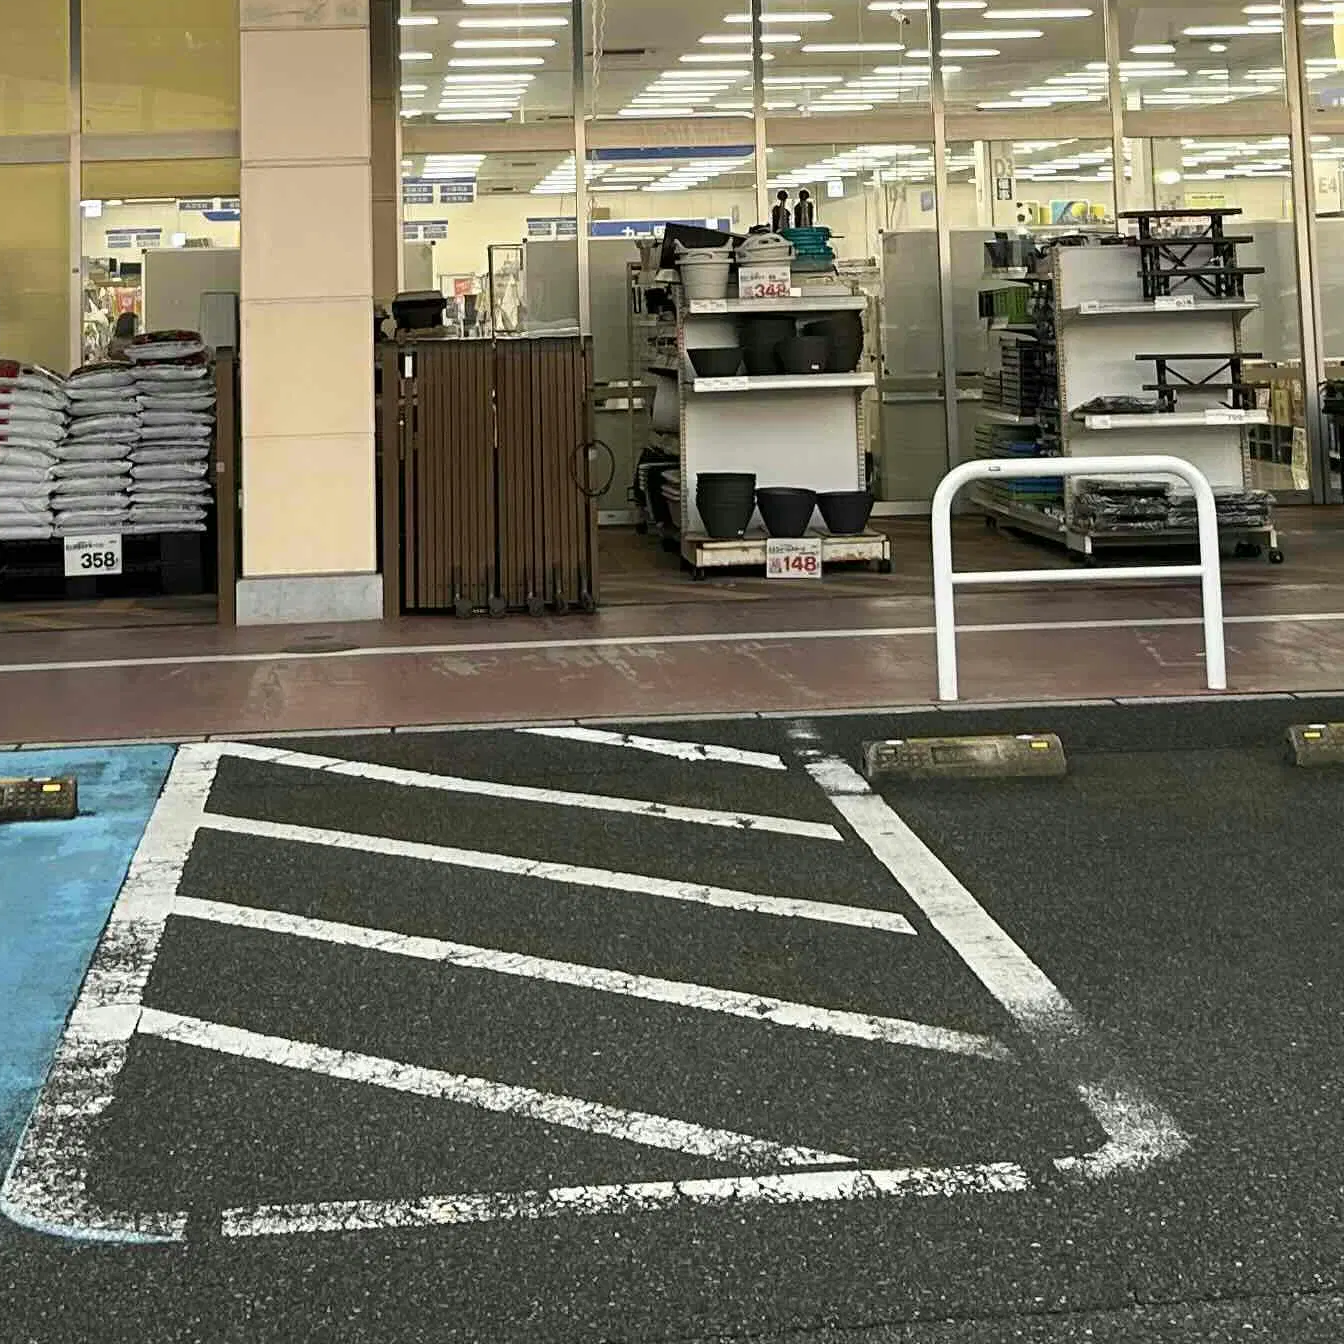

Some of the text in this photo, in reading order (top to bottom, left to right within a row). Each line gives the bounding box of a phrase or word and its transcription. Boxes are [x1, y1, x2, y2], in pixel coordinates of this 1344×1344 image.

[1318, 177, 1338, 194] E4
[80, 551, 115, 569] 358
[783, 555, 817, 572] 148
